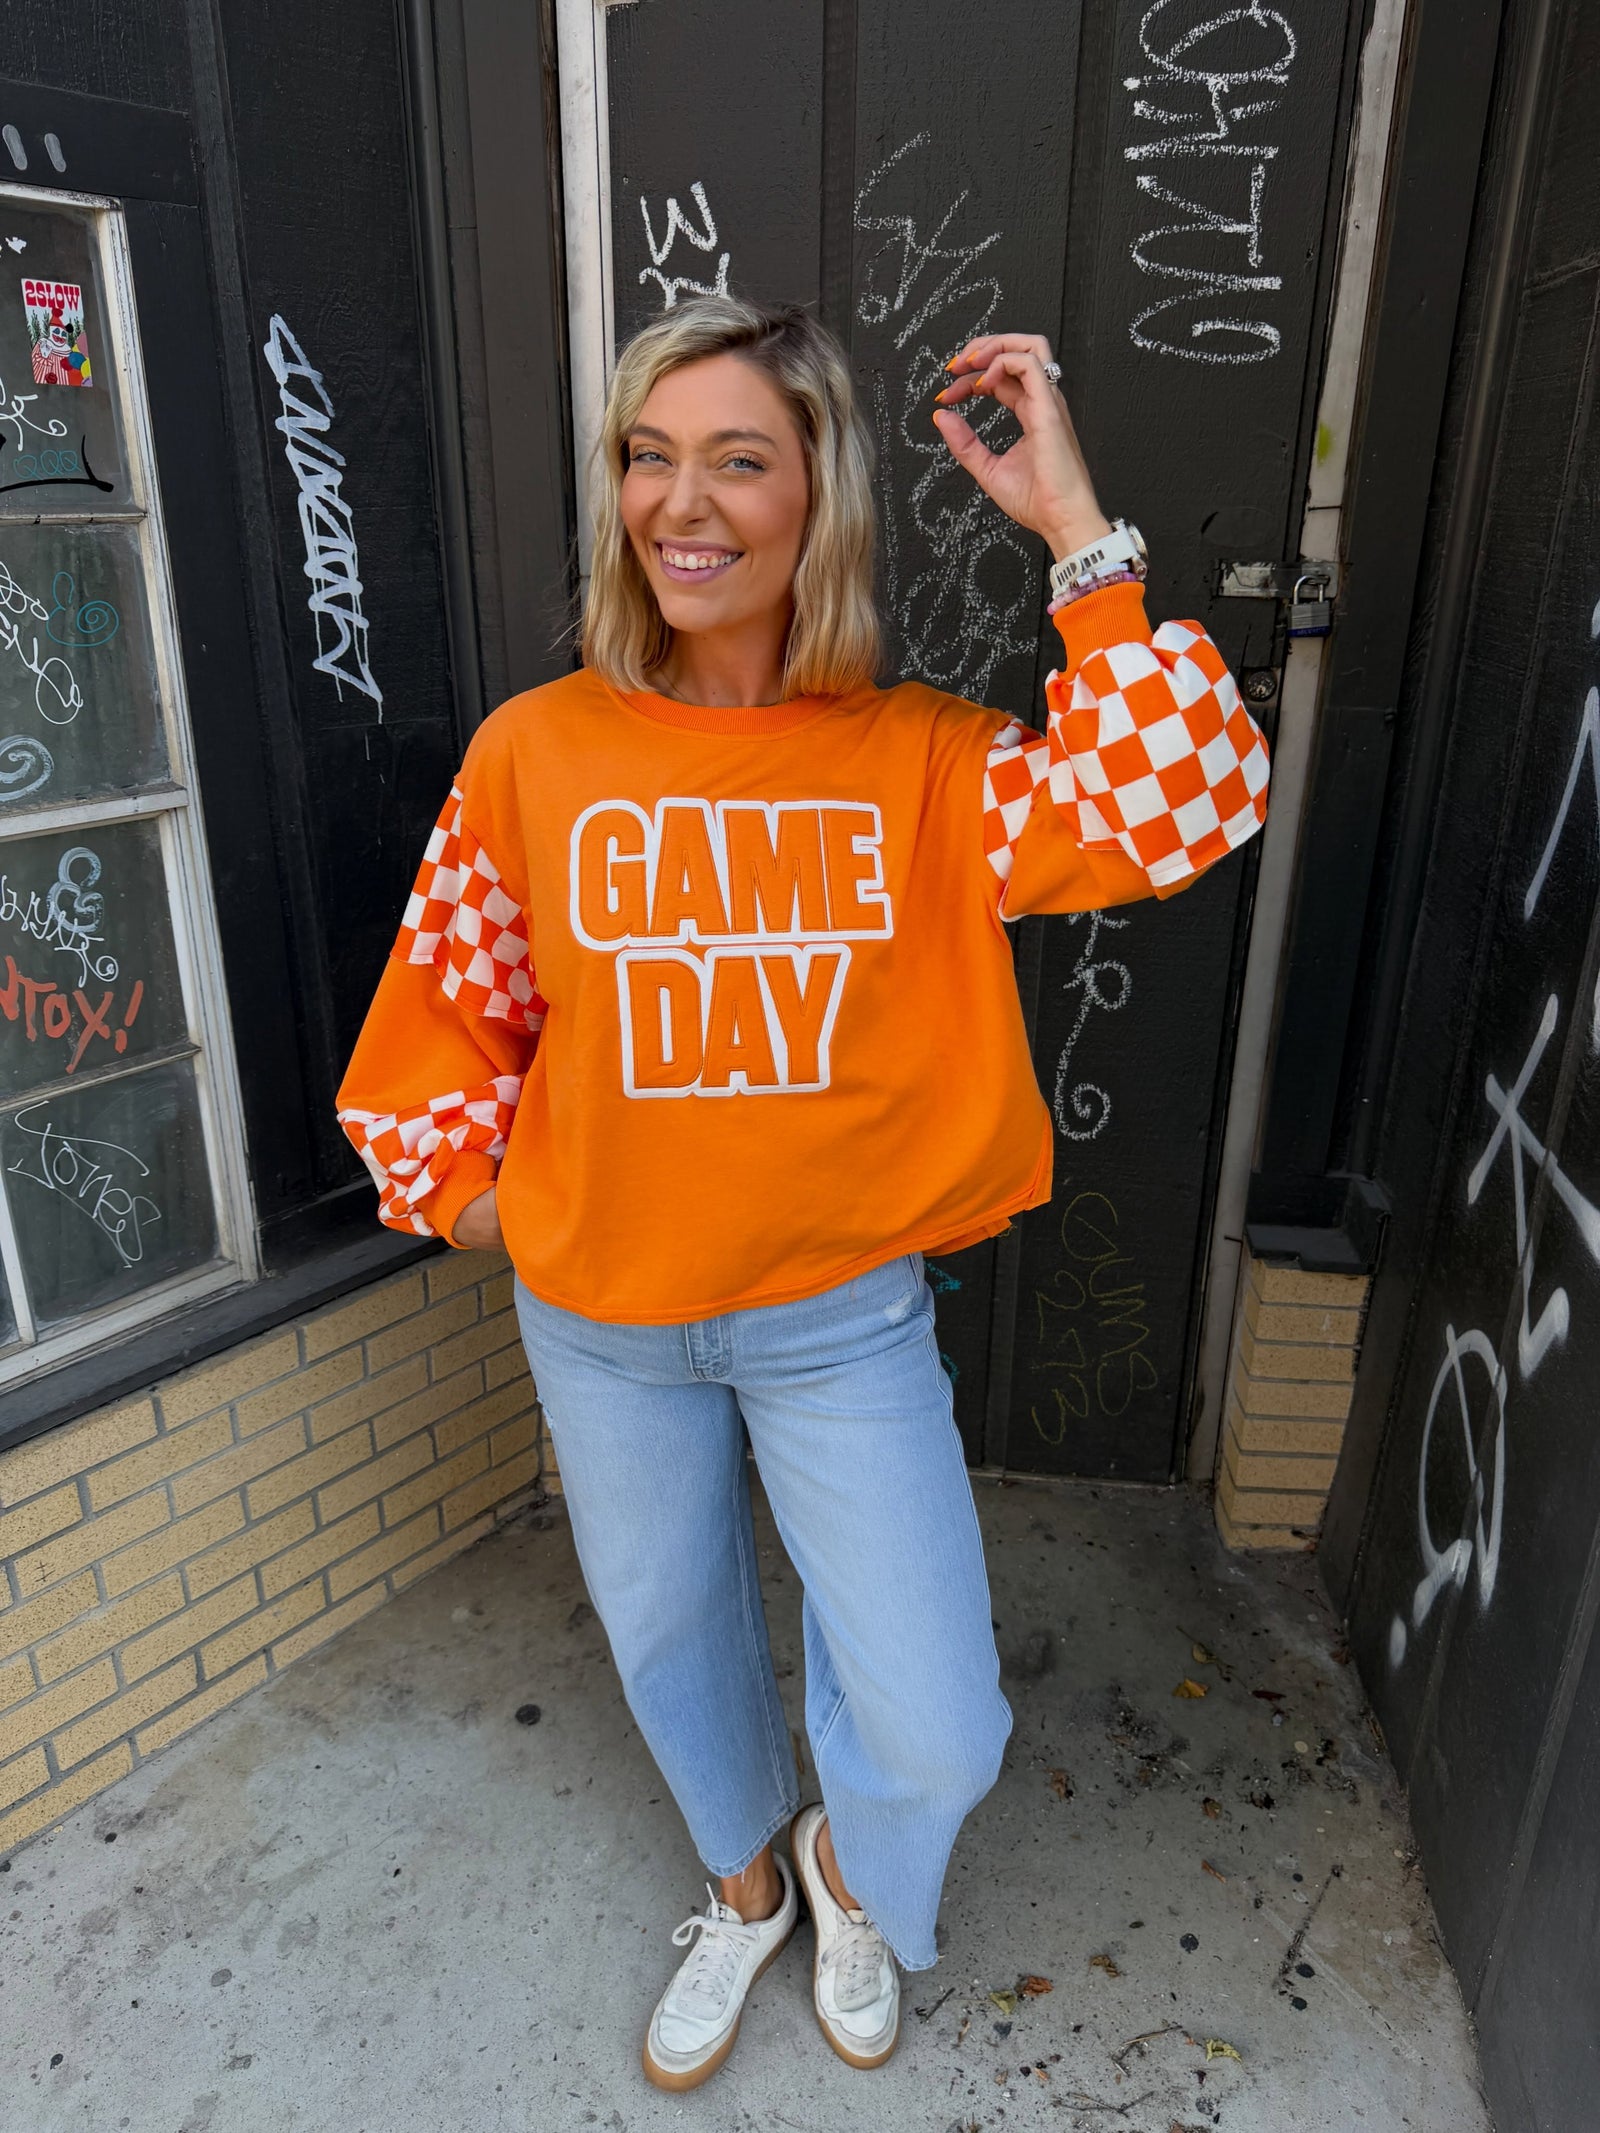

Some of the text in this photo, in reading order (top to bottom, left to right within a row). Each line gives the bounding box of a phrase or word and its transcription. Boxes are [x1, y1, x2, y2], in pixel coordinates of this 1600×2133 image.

[24, 280, 80, 312] 2SLOW
[570, 797, 893, 951] GAME
[615, 943, 852, 1098] DAY
